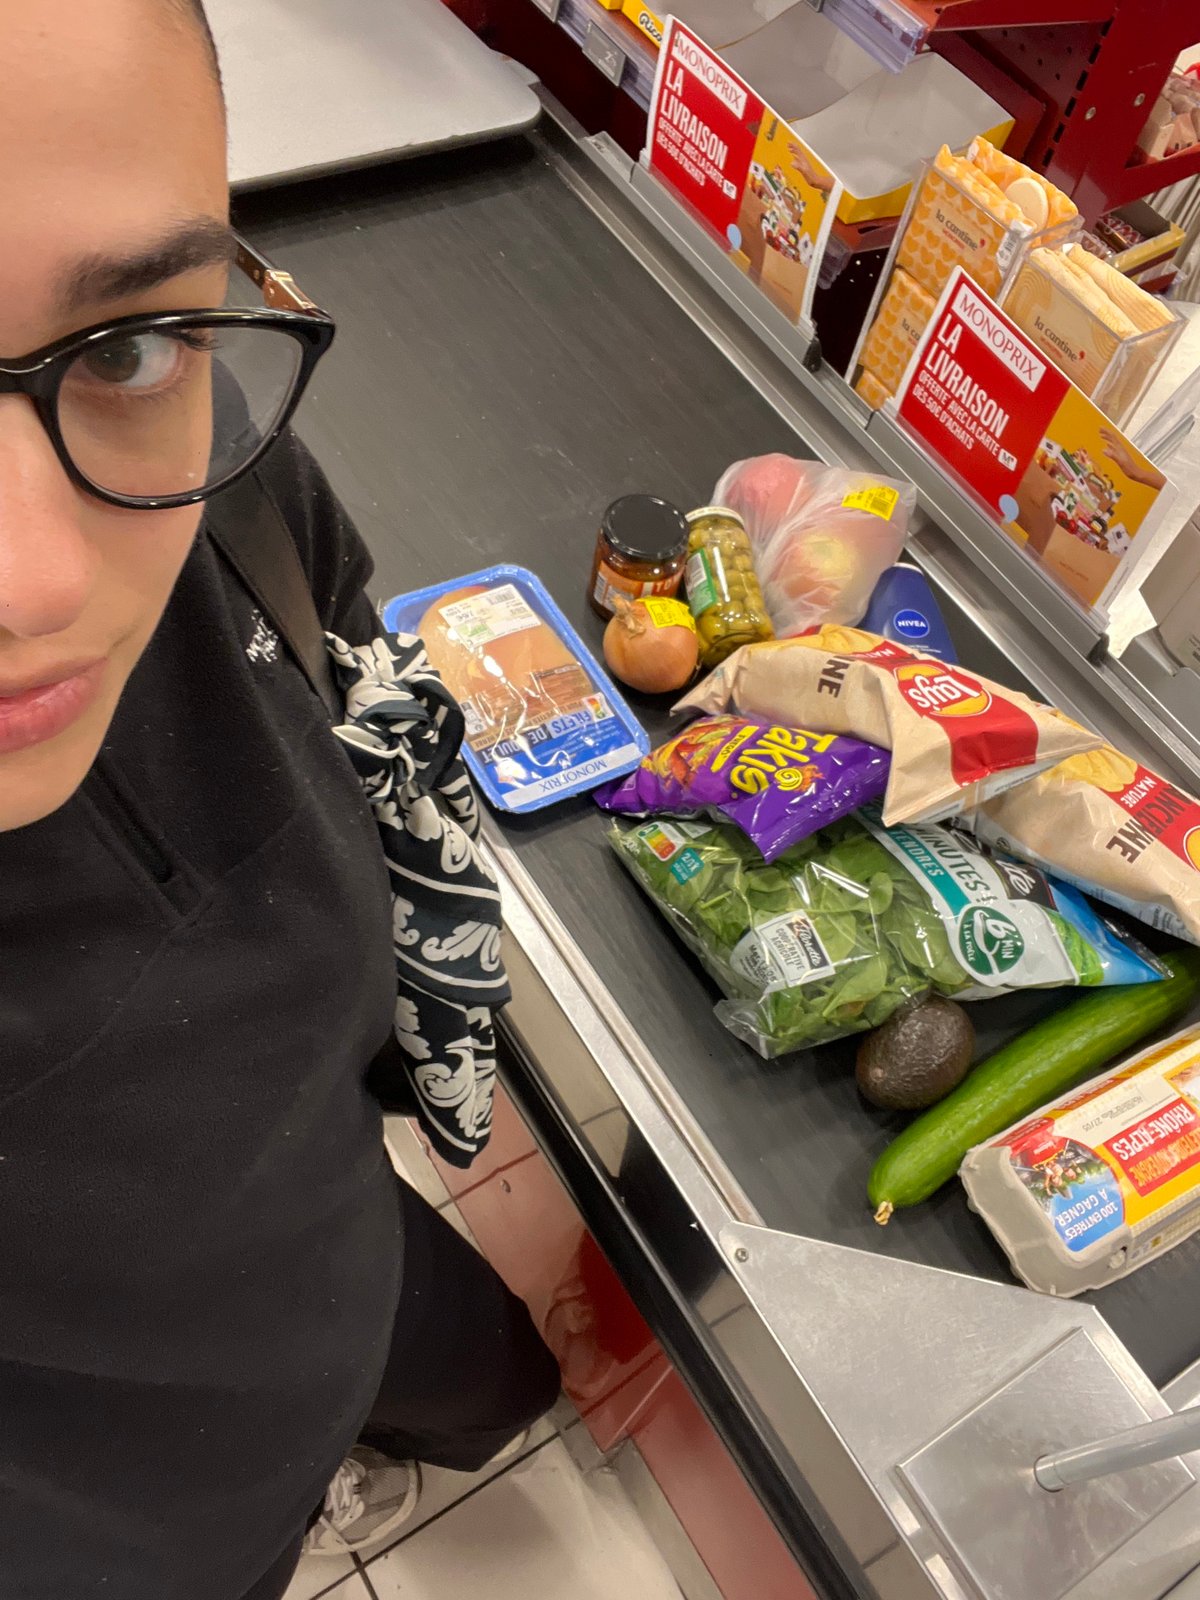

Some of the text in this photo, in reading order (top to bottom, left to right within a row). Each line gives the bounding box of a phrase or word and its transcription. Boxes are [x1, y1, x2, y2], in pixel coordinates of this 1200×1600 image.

[638, 12, 662, 42] Rico
[665, 60, 684, 97] LA
[678, 42, 742, 110] MONOPRIX
[660, 89, 729, 171] LIVRAISON
[935, 209, 945, 223] la
[945, 219, 978, 251] cantine
[910, 327, 922, 342] ca
[937, 313, 963, 354] LA
[960, 294, 1038, 381] MONOPRIX
[1034, 316, 1045, 332] la
[1045, 327, 1077, 361] cantine
[925, 341, 1010, 438] LIVRAISON
[912, 383, 929, 404] DÈS
[940, 411, 975, 451] D'ACHATS
[948, 399, 967, 425] AVEC
[965, 416, 977, 433] LA
[975, 424, 1001, 457] CARTE
[897, 620, 926, 628] NIVEA
[907, 674, 981, 712] Lay's
[480, 737, 527, 764] OULET
[527, 726, 548, 745] DE
[730, 727, 839, 795] Takis
[1120, 775, 1157, 809] NATURE
[1105, 783, 1193, 864] ANCIENNE
[890, 829, 945, 877] TENDRES
[793, 918, 823, 967] Florette
[1001, 939, 1014, 960] MIN
[1112, 1103, 1196, 1161] RHÔNE-ALPES
[1055, 1187, 1108, 1227] À GAGNER
[1064, 1212, 1102, 1241] ENTRÉES
[1101, 1201, 1119, 1218] 100
